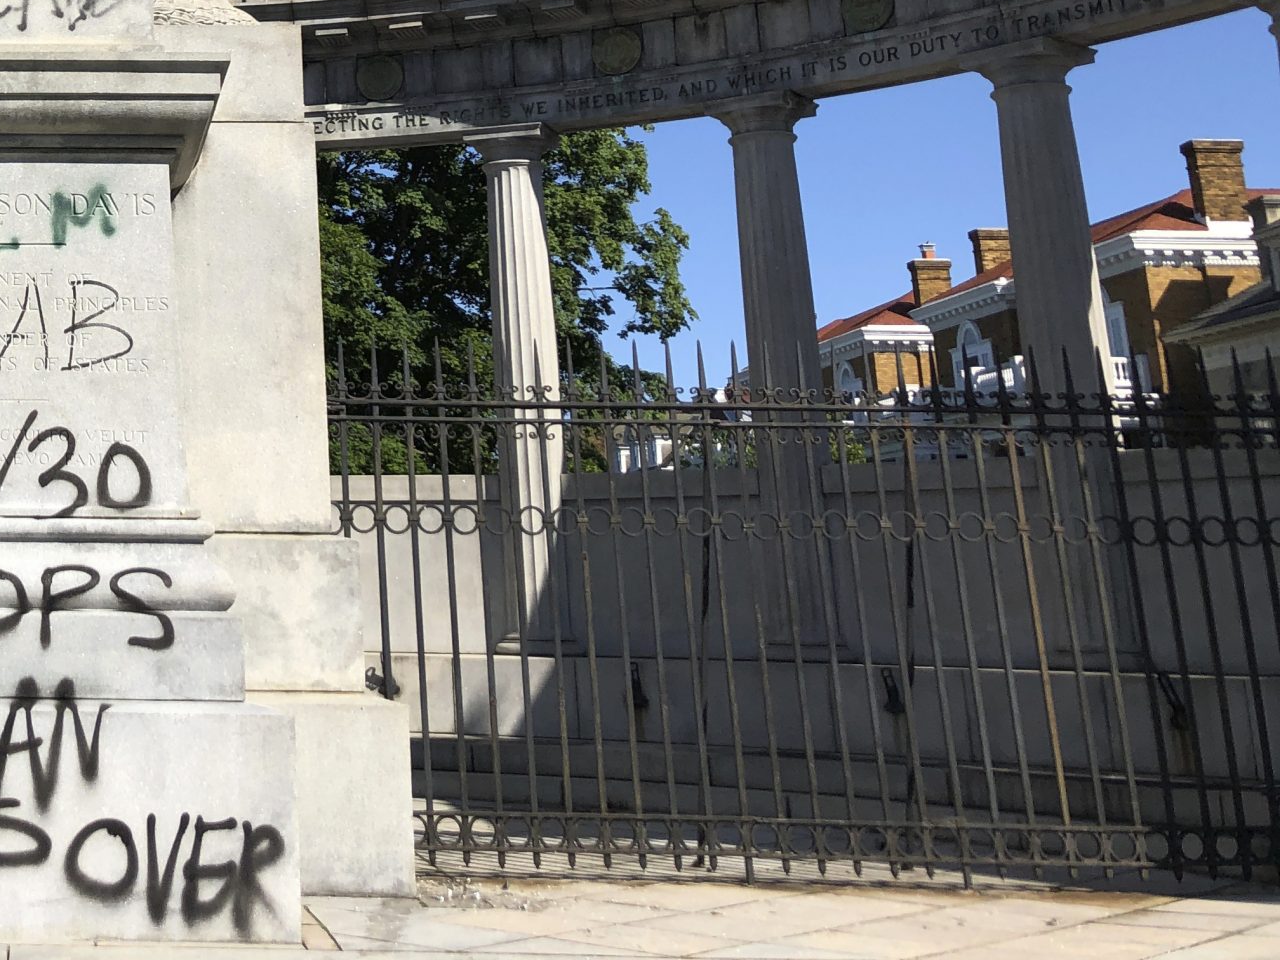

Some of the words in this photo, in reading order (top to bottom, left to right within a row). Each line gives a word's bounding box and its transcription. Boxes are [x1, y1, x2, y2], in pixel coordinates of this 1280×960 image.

[392, 114, 429, 128] THE
[439, 105, 511, 124] RIGHTS
[523, 102, 547, 116] WE
[678, 79, 718, 98] AND
[727, 66, 792, 90] WHICH
[801, 60, 818, 78] IT
[829, 56, 847, 73] IS
[858, 46, 899, 67] OUR
[910, 31, 962, 57] DUTY
[970, 25, 1000, 42] TO
[71, 192, 157, 216] DAVIS
[55, 296, 170, 312] PRINCIPLES
[64, 812, 286, 938] OVER
